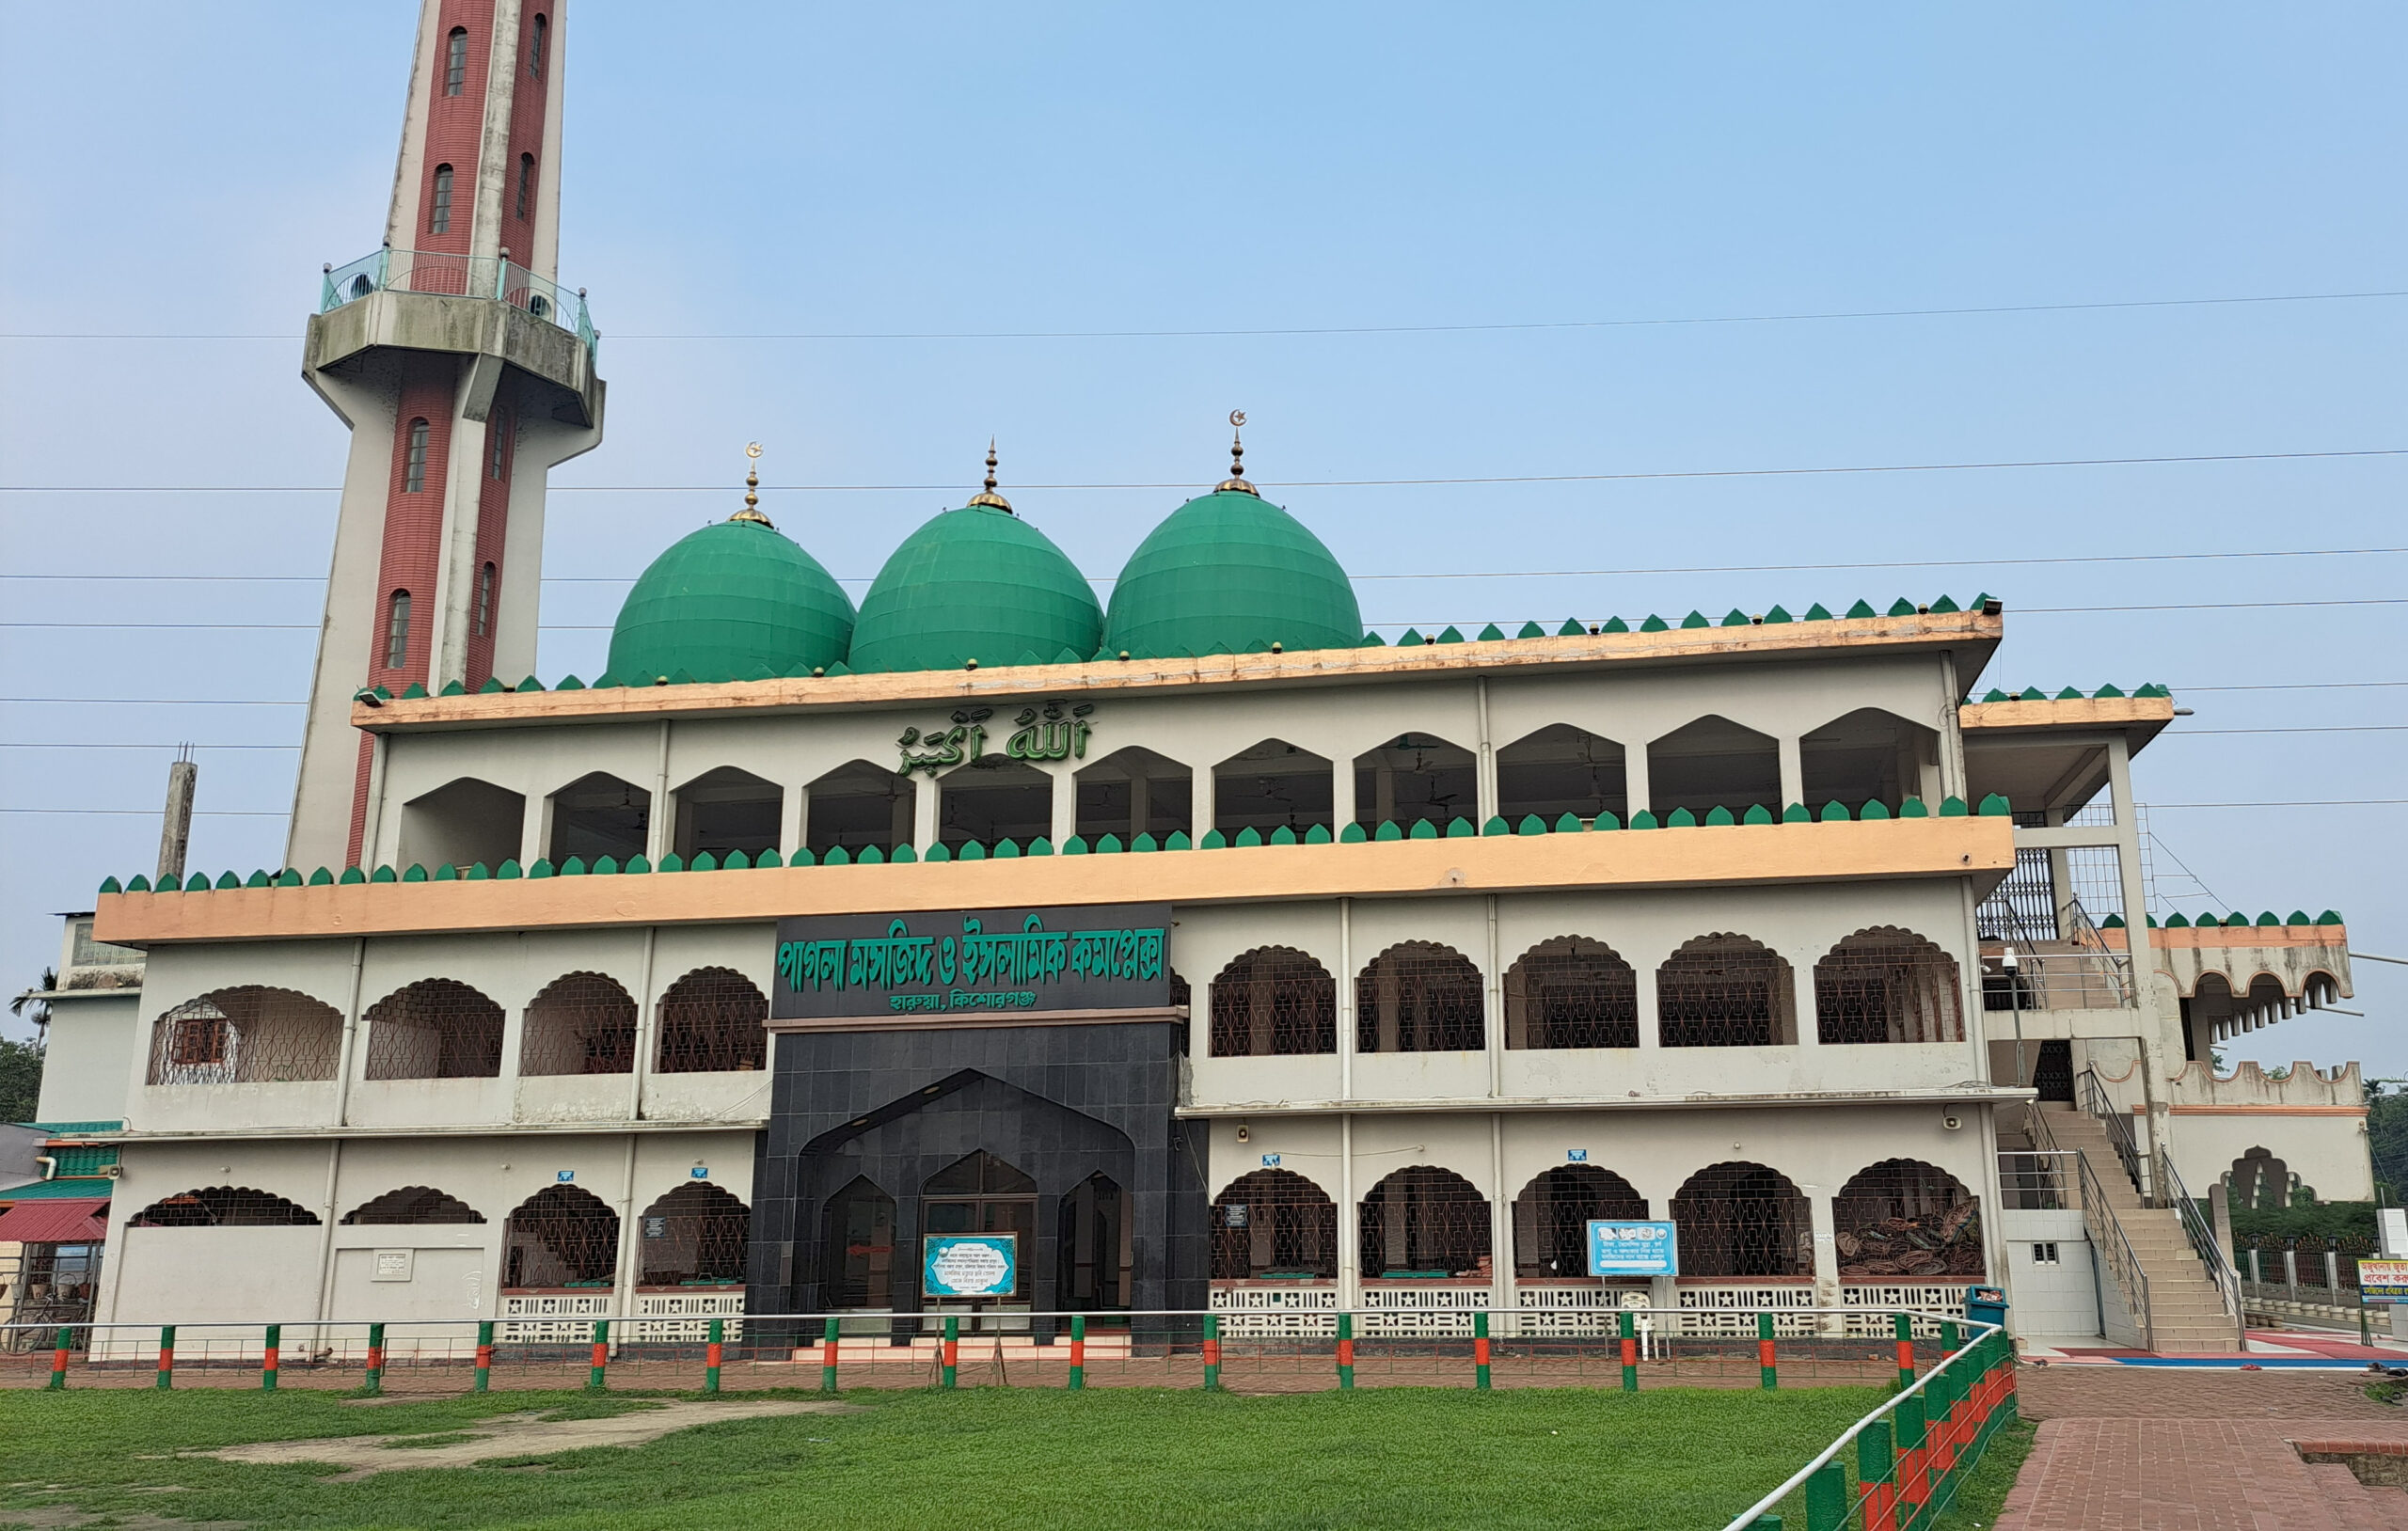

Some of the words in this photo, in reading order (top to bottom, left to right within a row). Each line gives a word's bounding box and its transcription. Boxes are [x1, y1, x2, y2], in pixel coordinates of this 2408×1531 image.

[778, 940, 847, 992] পাগলা
[850, 919, 934, 990] মসজিদ
[939, 936, 957, 985] ও
[962, 913, 1068, 986] ইসলামিক
[1070, 928, 1165, 982] কমপ্লেক্স
[949, 988, 1037, 1009] কিশোরগঞ্জ
[2364, 1274, 2389, 1284] প্রবেশ
